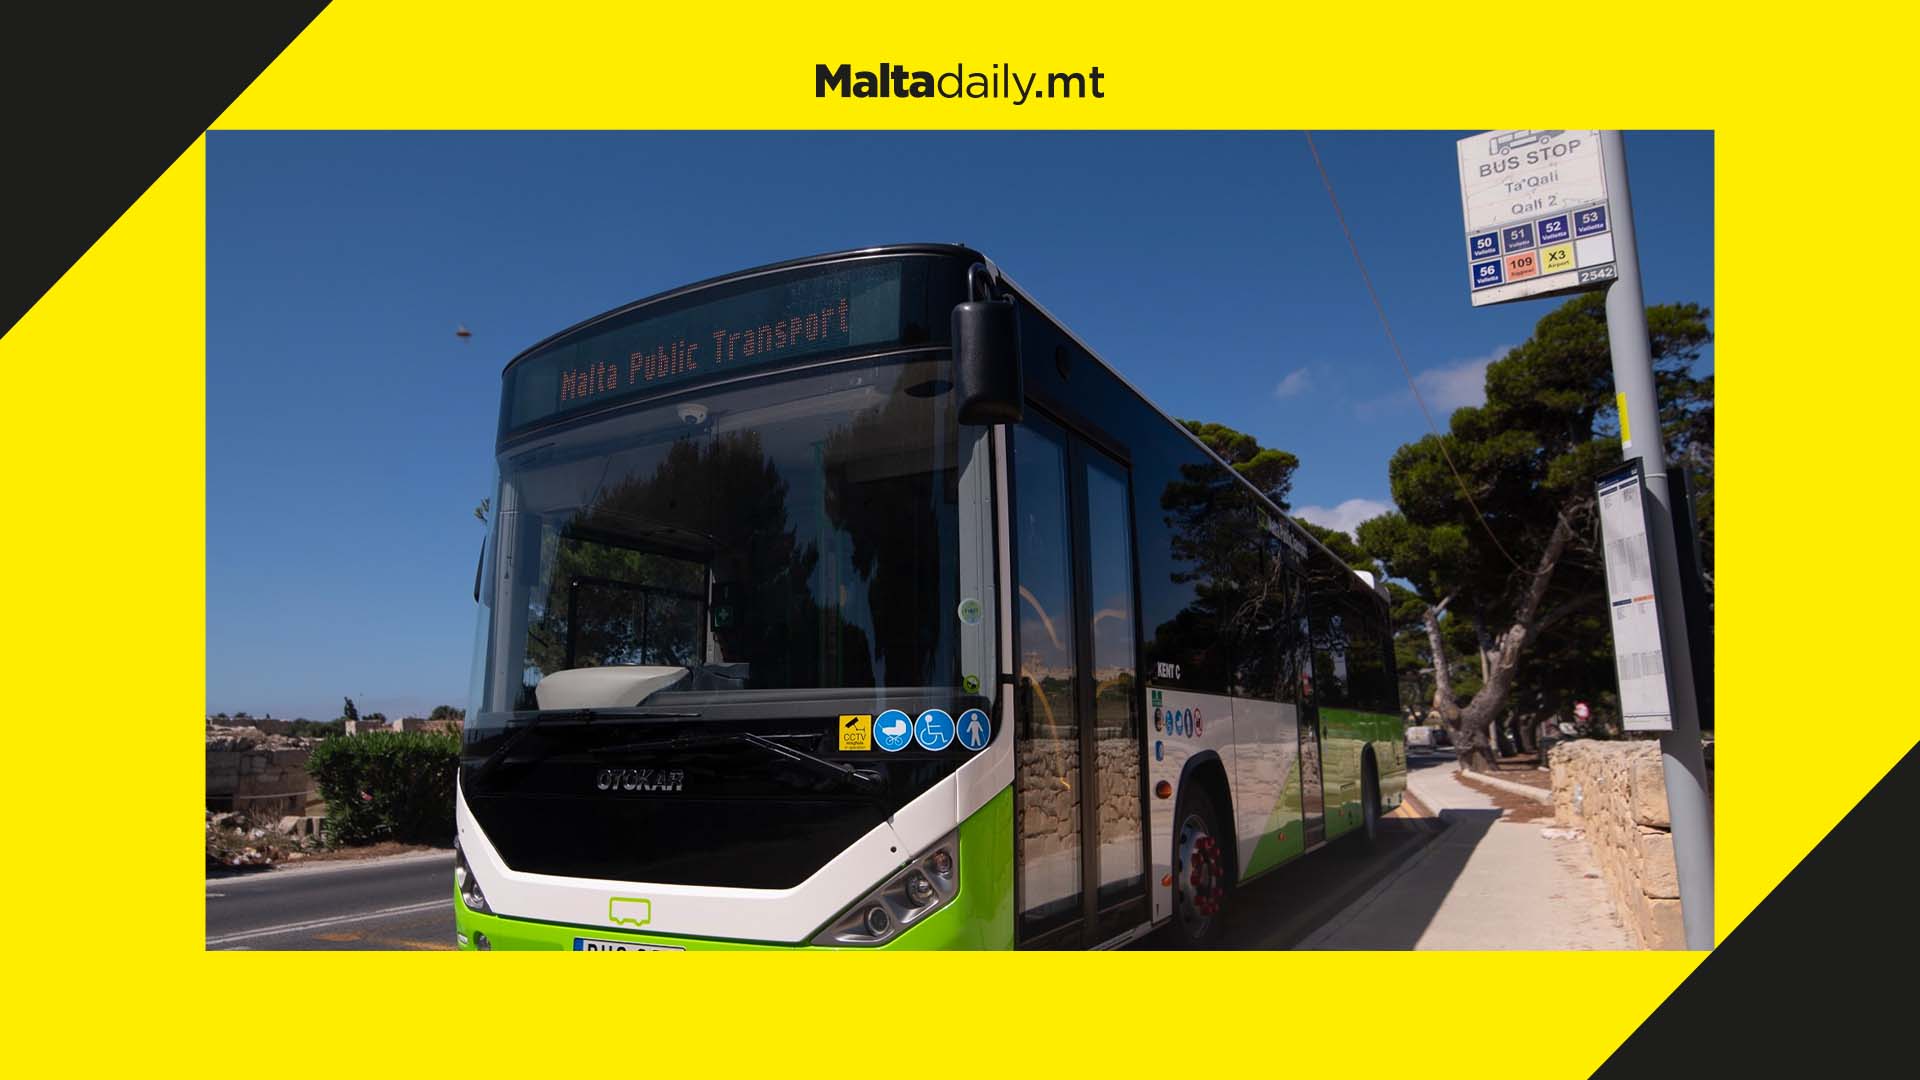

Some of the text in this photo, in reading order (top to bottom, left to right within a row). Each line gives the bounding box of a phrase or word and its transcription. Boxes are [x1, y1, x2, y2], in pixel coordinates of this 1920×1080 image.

[1479, 139, 1581, 177] BUS STOP
[1548, 195, 1558, 207] 2
[1582, 212, 1598, 224] 53
[1545, 221, 1561, 233] 52
[1510, 229, 1525, 240] 51
[1477, 237, 1492, 249] 50
[1548, 250, 1566, 261] X3
[1511, 257, 1532, 269] 109
[1480, 265, 1495, 277] 56
[1581, 267, 1614, 282] 2542
[560, 297, 849, 400] Malta Public Transport
[1157, 661, 1181, 680] KENT C
[844, 733, 866, 741] CCTV
[597, 769, 685, 791] OTOKAR
